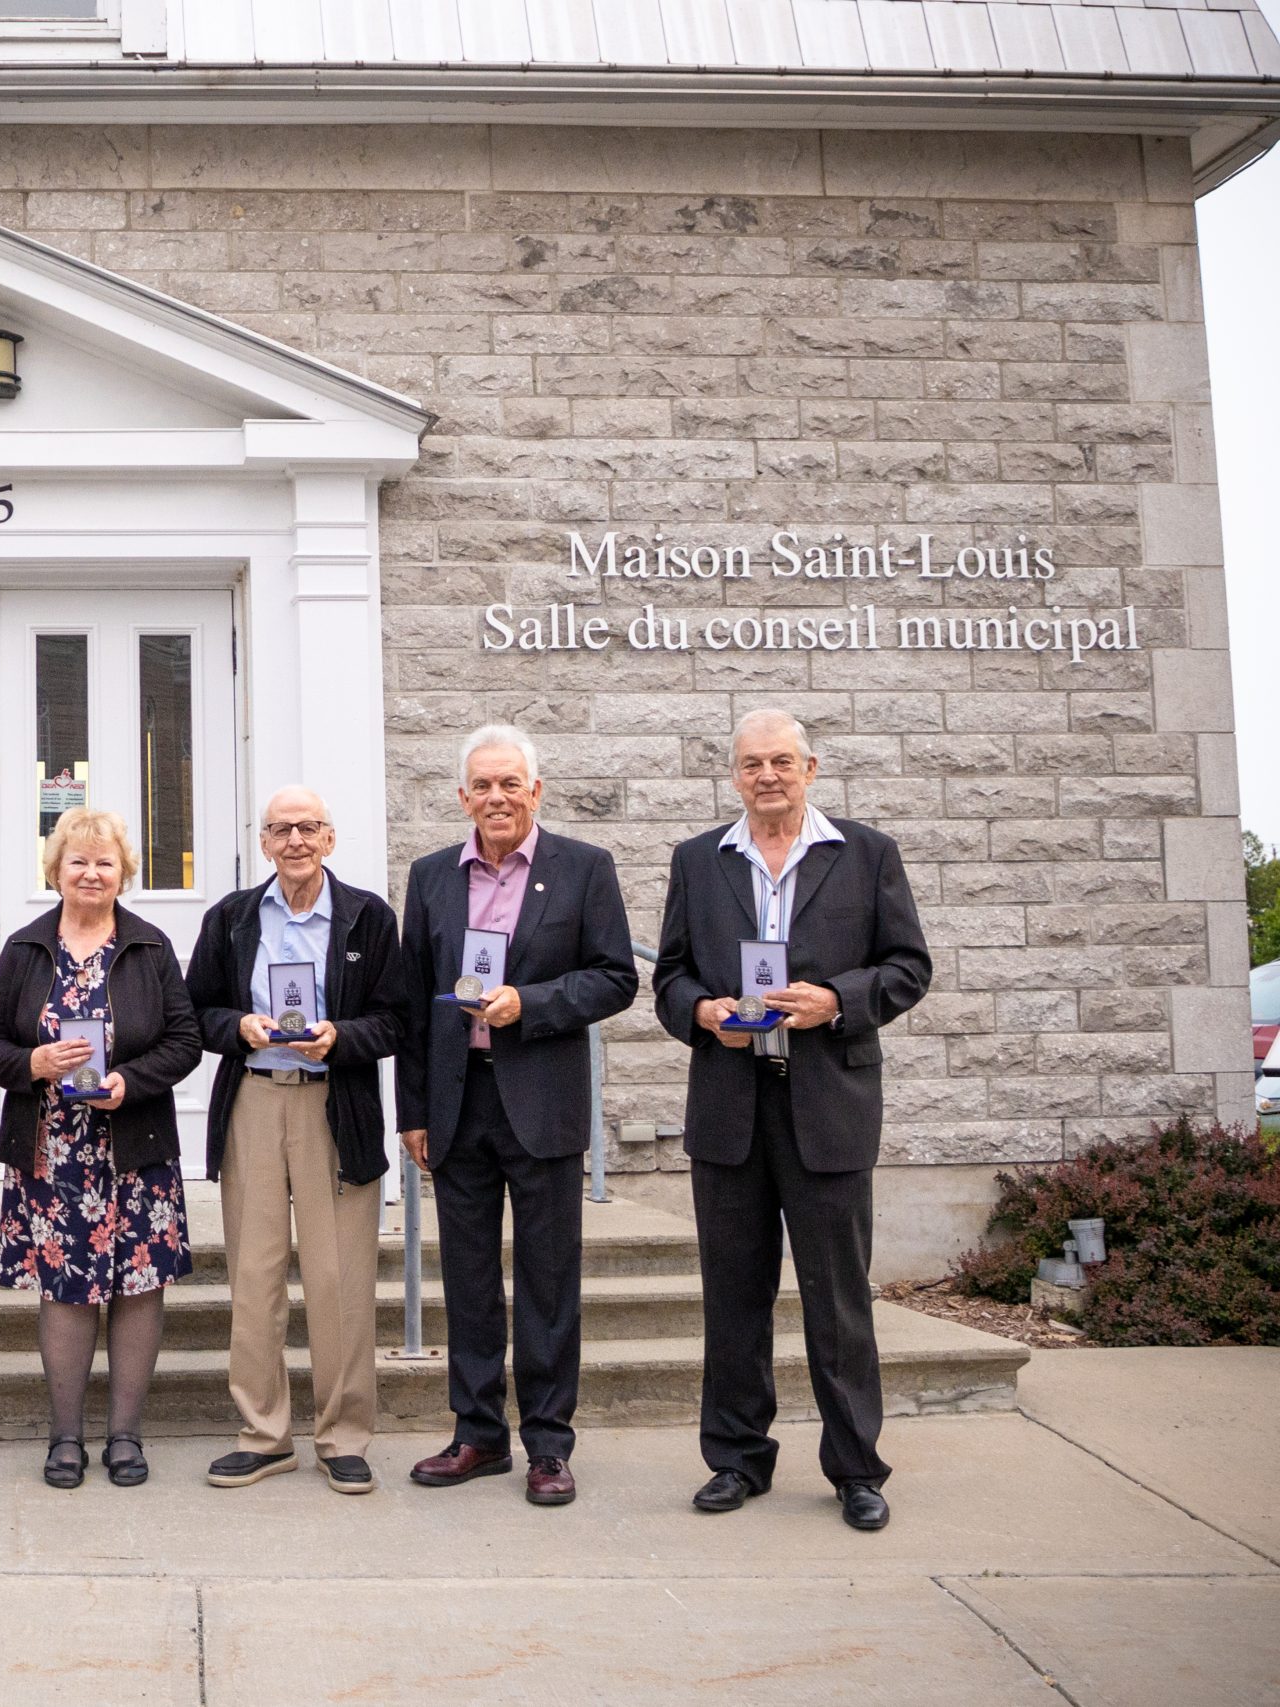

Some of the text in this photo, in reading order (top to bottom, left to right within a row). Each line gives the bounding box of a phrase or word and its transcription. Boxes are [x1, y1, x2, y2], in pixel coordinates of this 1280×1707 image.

[565, 531, 1056, 579] Maison Saint-Louis
[483, 603, 1142, 663] Salle du conseil municipal
